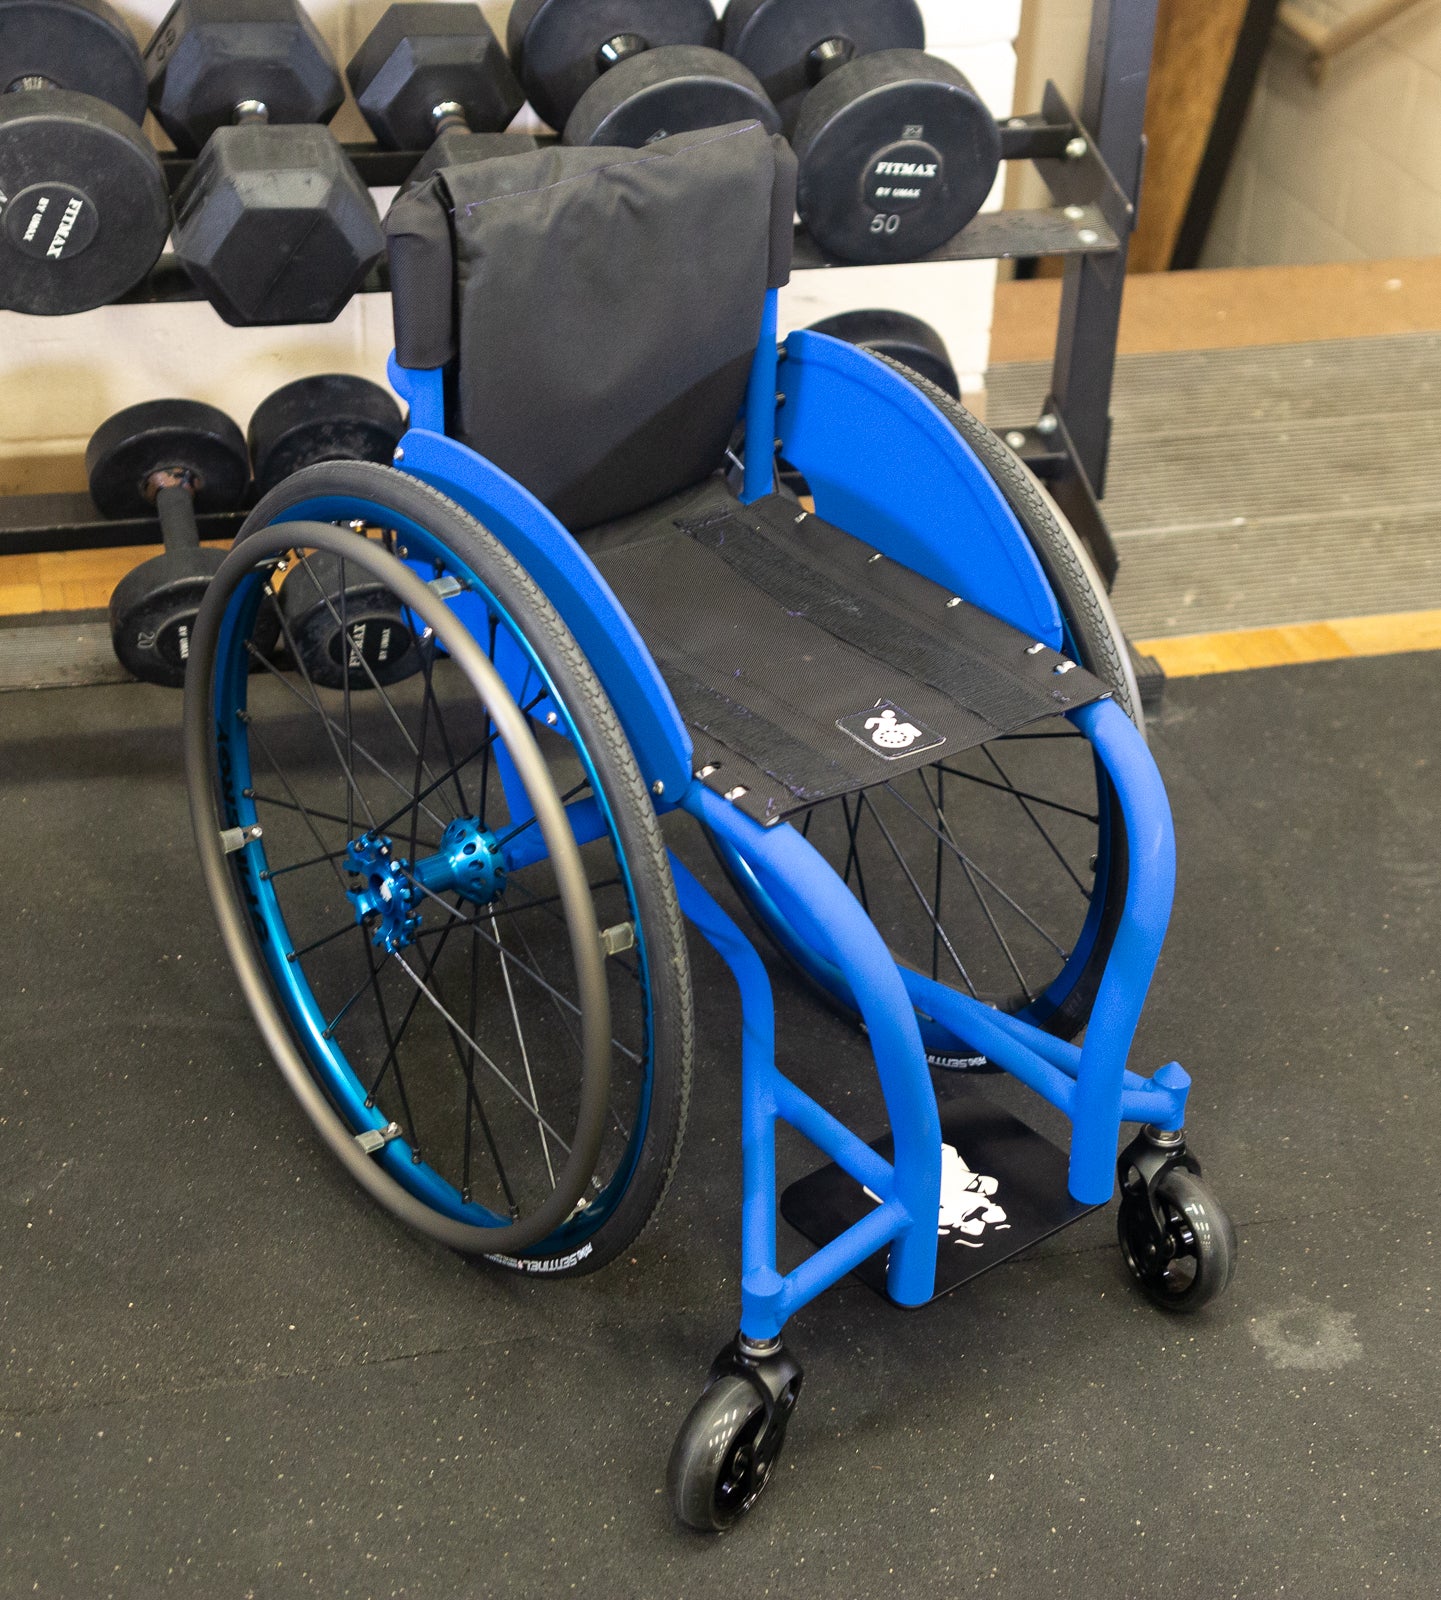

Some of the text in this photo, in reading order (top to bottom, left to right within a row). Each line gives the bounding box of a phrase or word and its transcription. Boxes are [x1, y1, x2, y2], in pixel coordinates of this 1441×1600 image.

[875, 161, 938, 177] FITMAX
[875, 186, 921, 198] BY UMAX
[22, 196, 50, 242] BY UMAX
[46, 197, 84, 259] FITMAX
[869, 213, 901, 234] 50
[136, 631, 155, 650] 20
[523, 1252, 578, 1273] SENTINEL
